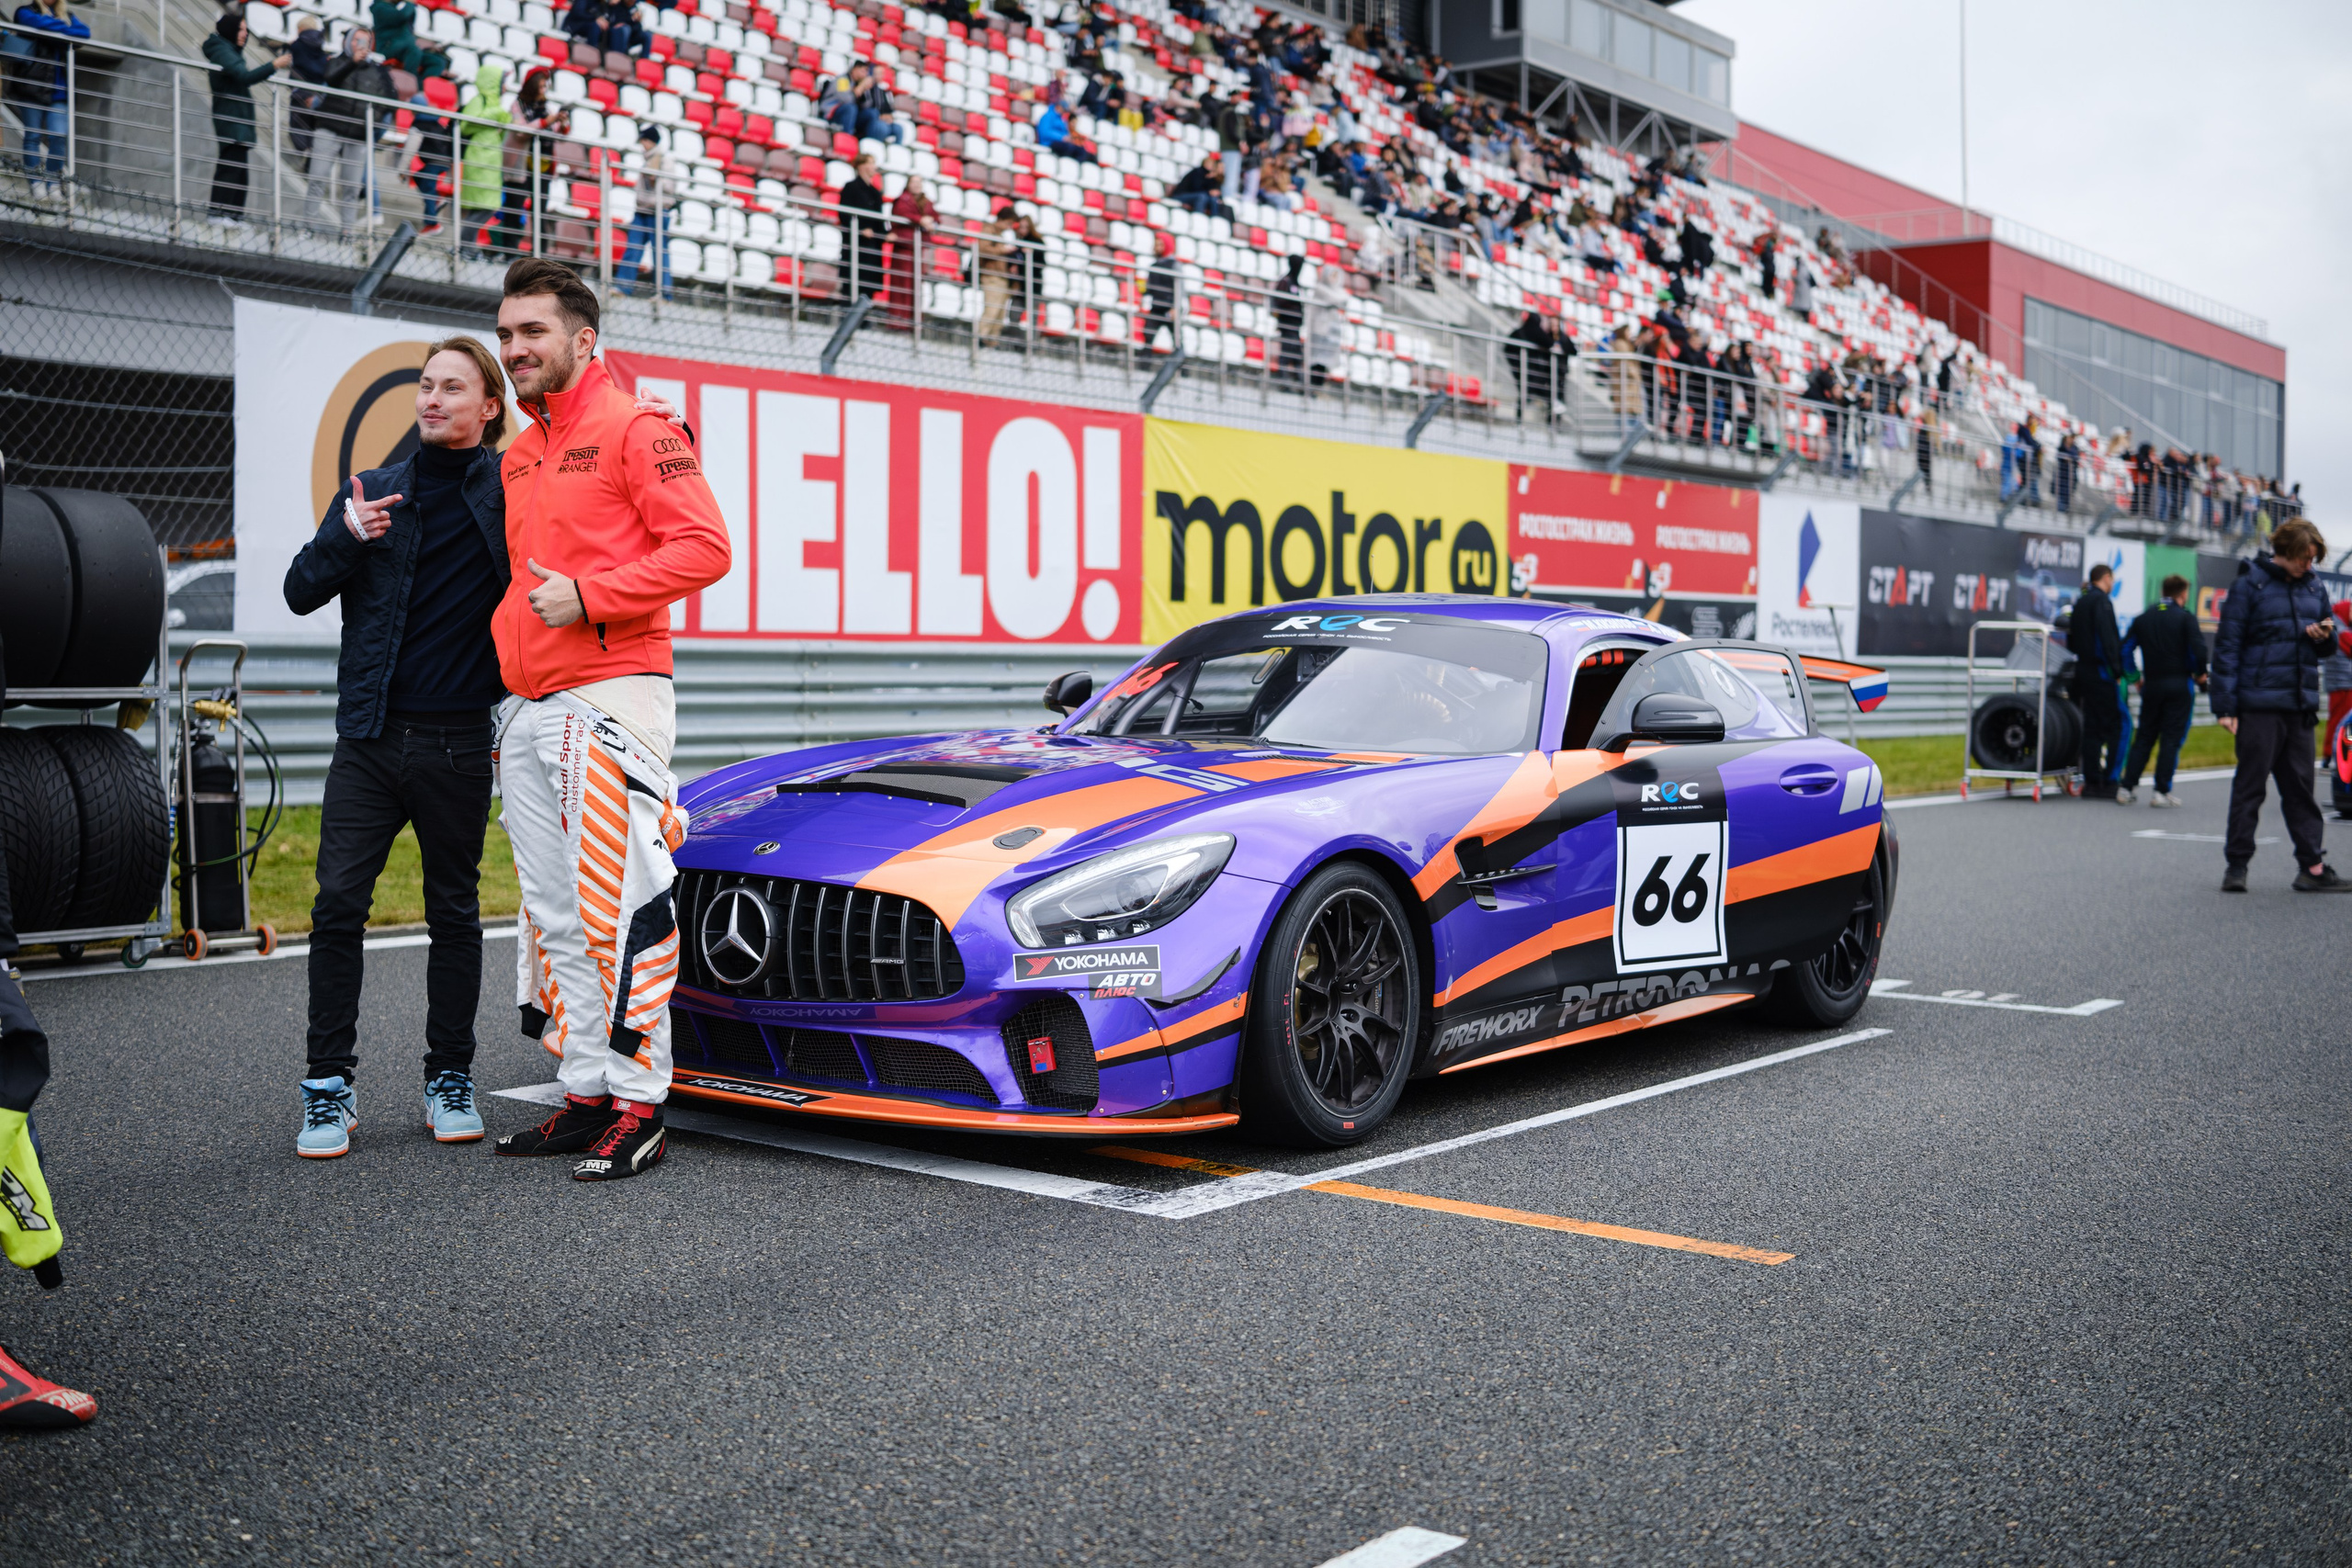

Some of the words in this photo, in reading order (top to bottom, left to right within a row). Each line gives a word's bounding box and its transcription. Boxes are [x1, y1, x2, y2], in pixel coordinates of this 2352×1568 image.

[562, 446, 600, 462] Tresor
[654, 457, 697, 477] Tresor
[636, 378, 1122, 640] HELLO!
[1156, 490, 1442, 605] motor
[1457, 548, 1492, 588] ru
[1868, 565, 1935, 607] СТАРТ
[1953, 573, 2010, 613] СТАРТ
[560, 713, 574, 764] Sport
[576, 719, 585, 742] raci
[560, 768, 569, 809] Audi
[571, 747, 582, 813] customer
[1632, 852, 1712, 927] 66
[1055, 952, 1148, 971] YOKOHAMA
[1098, 973, 1157, 987] АВТО
[1094, 987, 1136, 998] ПЛЮС
[1434, 1005, 1544, 1056] FIREWORX
[617, 1101, 631, 1110] OMP
[573, 1160, 613, 1172] OMP
